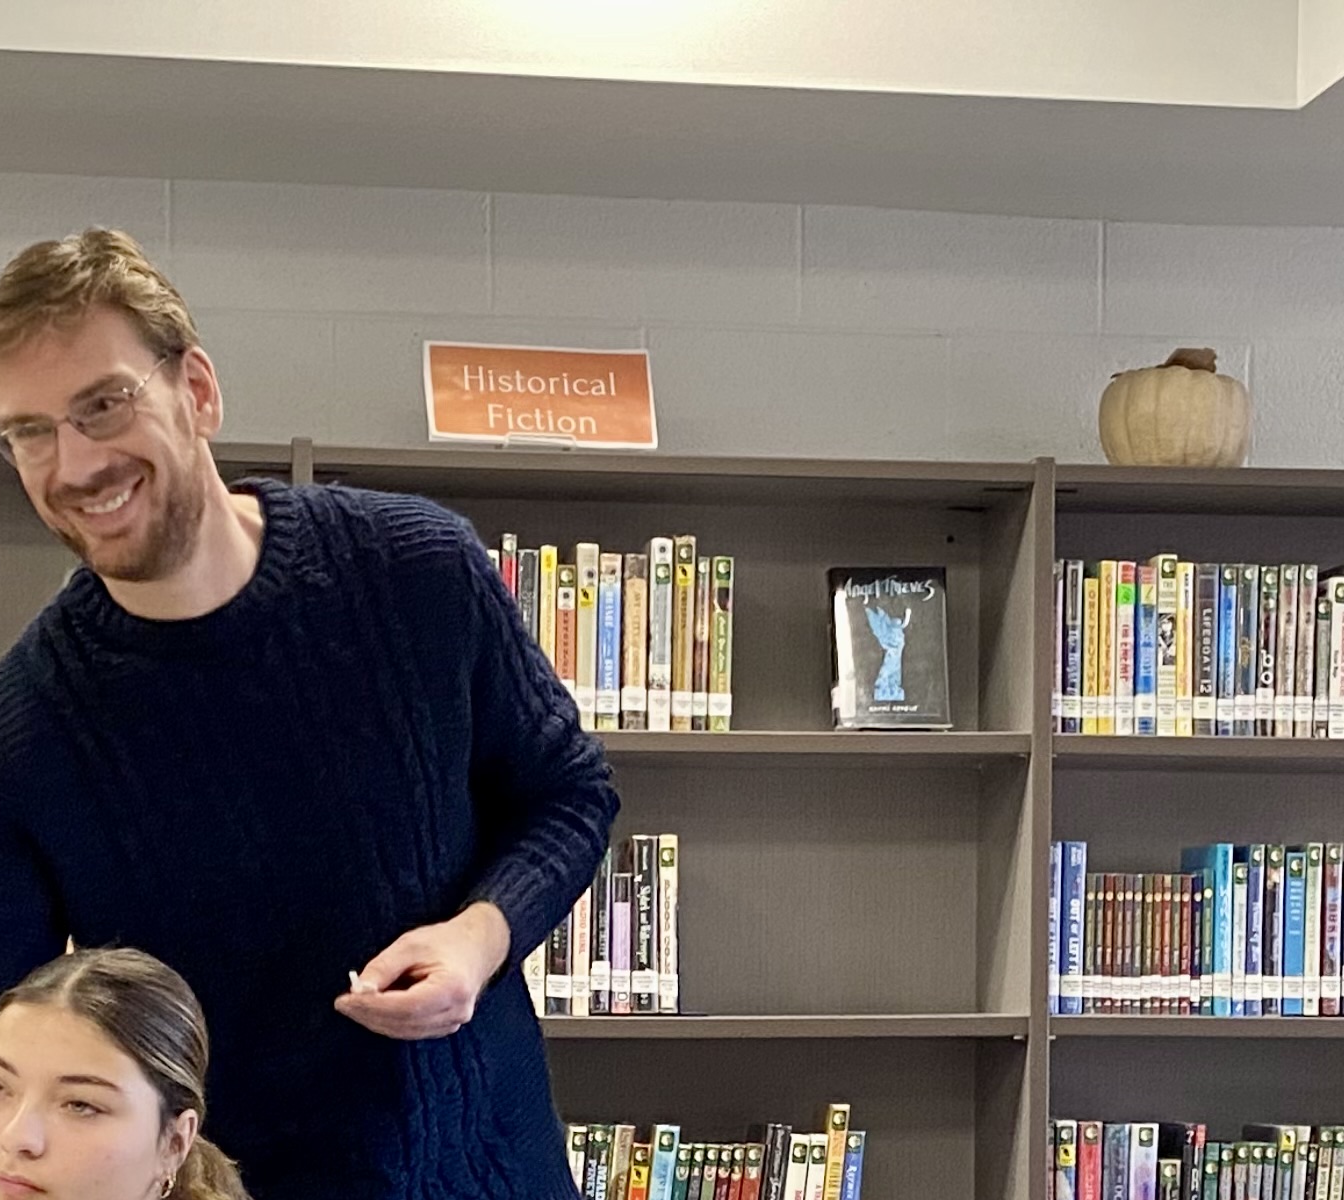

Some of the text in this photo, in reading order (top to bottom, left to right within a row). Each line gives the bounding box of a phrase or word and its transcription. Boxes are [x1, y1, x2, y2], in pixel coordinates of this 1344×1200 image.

[462, 364, 617, 397] Historical
[488, 403, 597, 434] Fiction
[844, 577, 879, 605] Angel
[1200, 608, 1213, 694] LIFEBOAT 12
[1069, 898, 1080, 921] OUT
